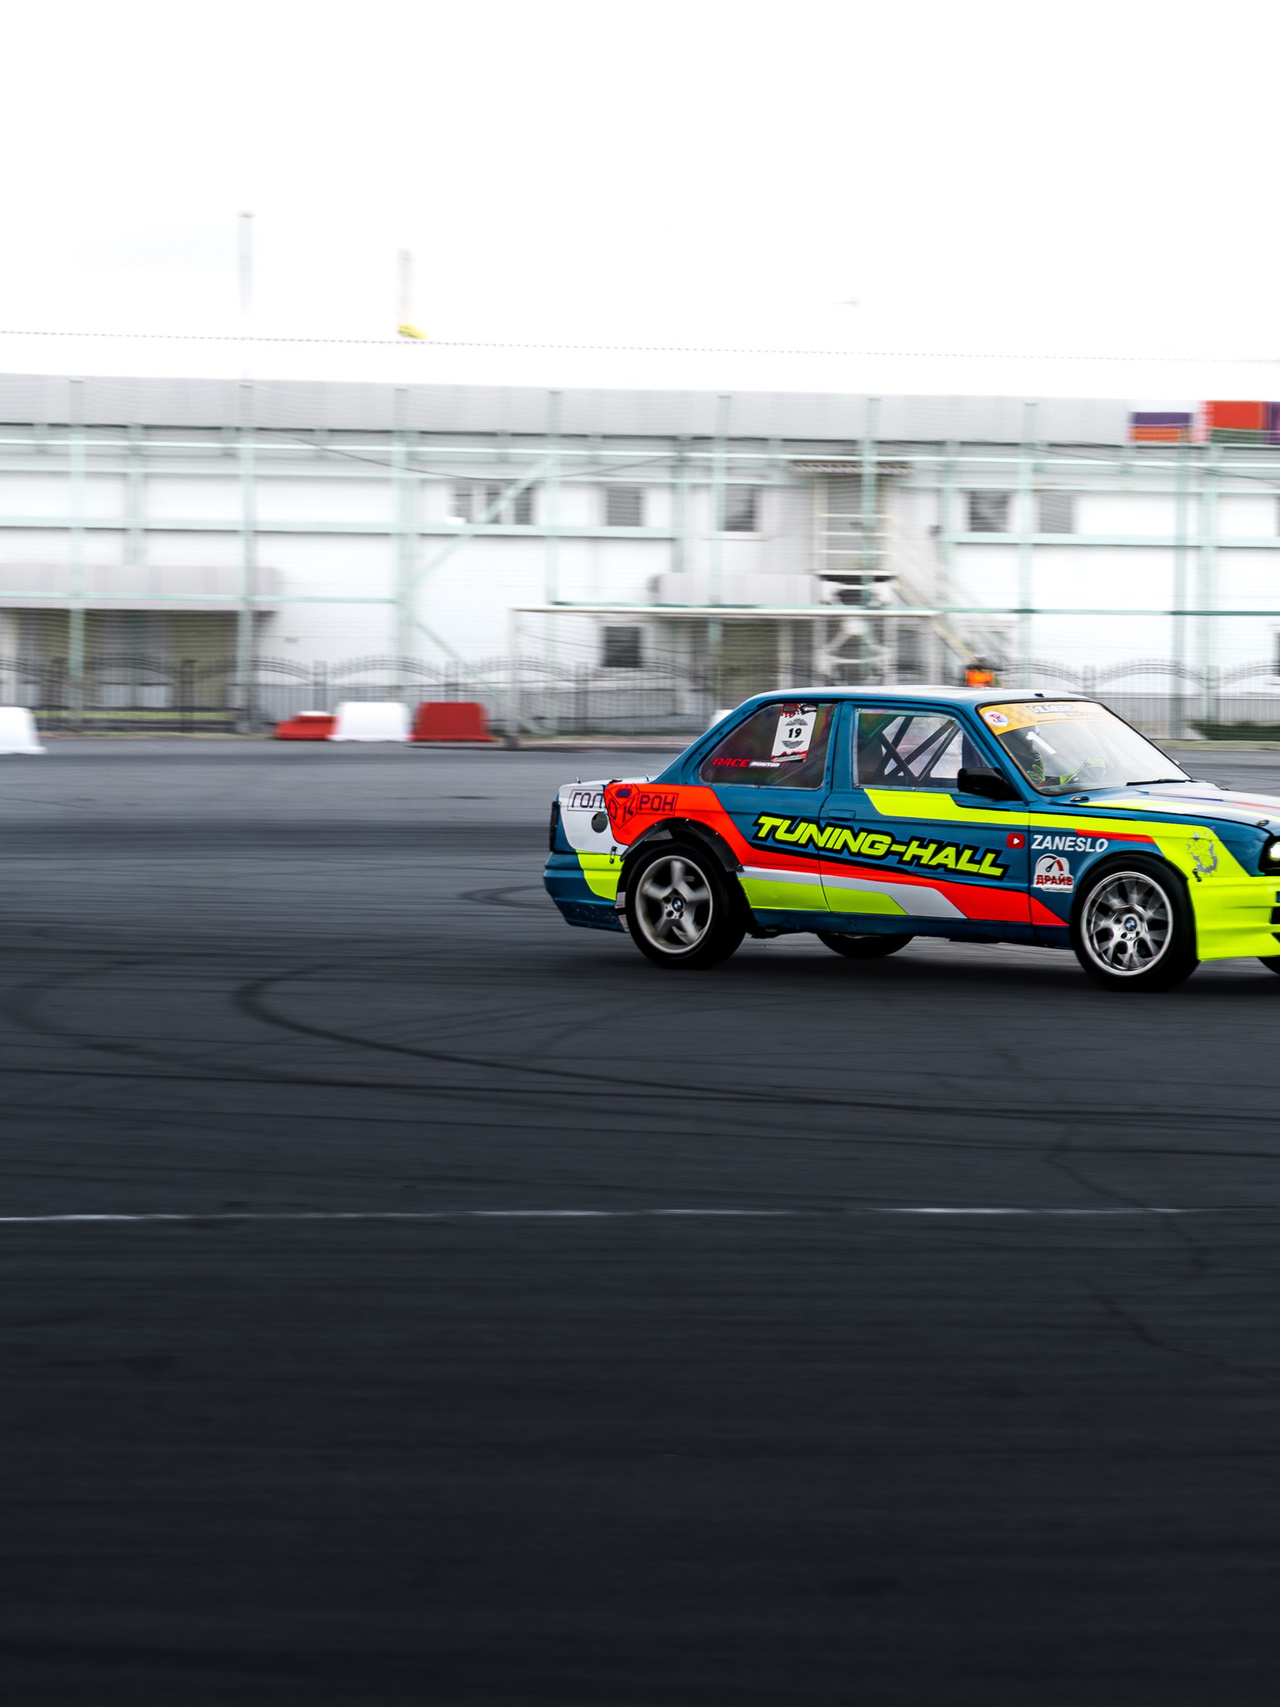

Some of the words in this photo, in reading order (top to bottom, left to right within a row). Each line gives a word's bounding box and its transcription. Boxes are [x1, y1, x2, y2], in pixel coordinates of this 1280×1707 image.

[788, 728, 802, 738] 19
[712, 757, 750, 768] RACE
[756, 815, 1004, 877] TUNING-HALL
[1031, 835, 1109, 853] ZANESLO
[1035, 873, 1074, 887] ДРАЙВ
